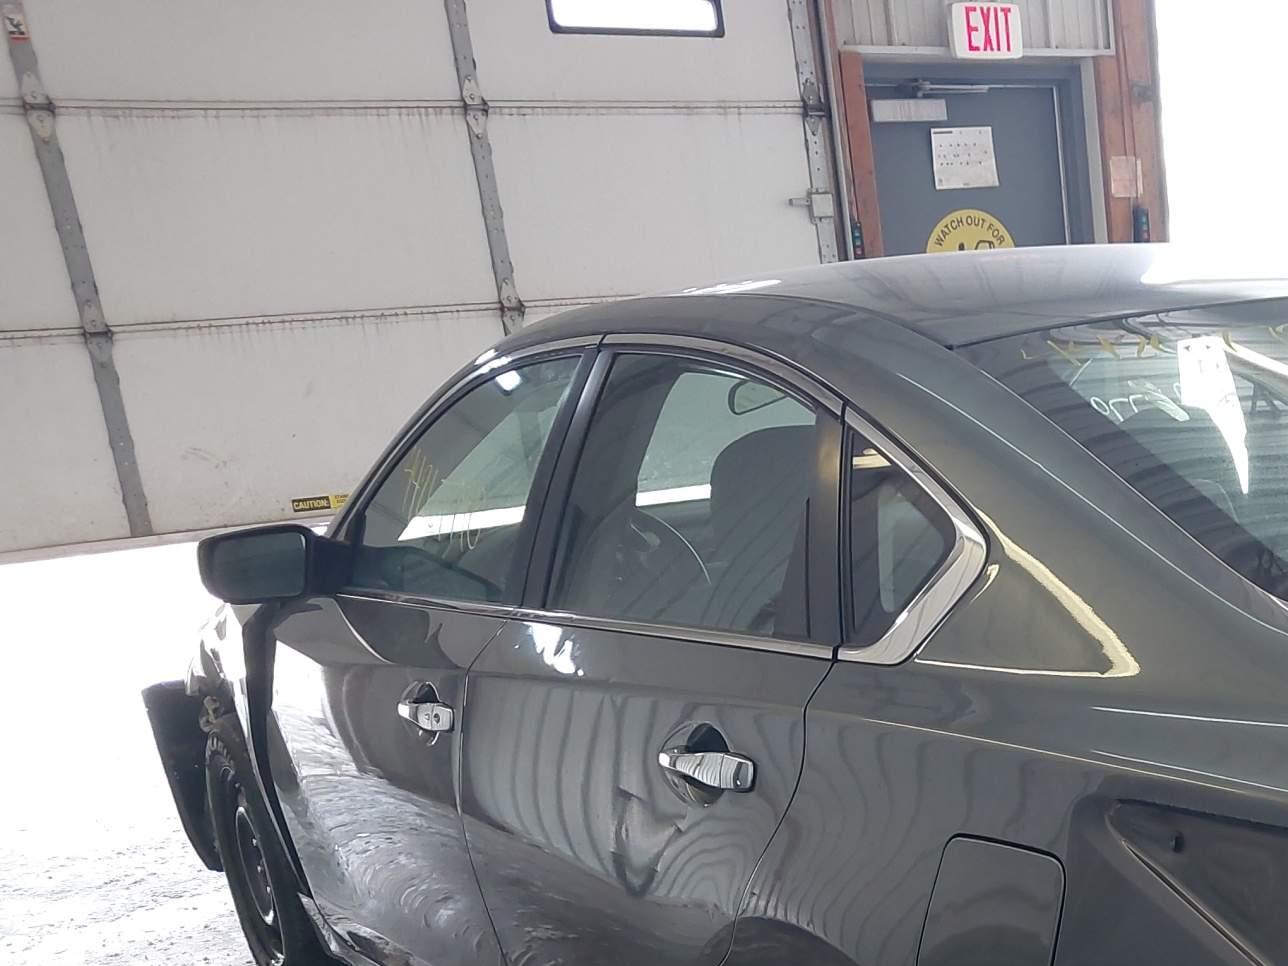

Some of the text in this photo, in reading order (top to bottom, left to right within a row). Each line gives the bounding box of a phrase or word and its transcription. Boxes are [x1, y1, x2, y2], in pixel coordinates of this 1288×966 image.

[964, 6, 1011, 52] EXIT
[934, 215, 1005, 247] WATCH OUT FOR
